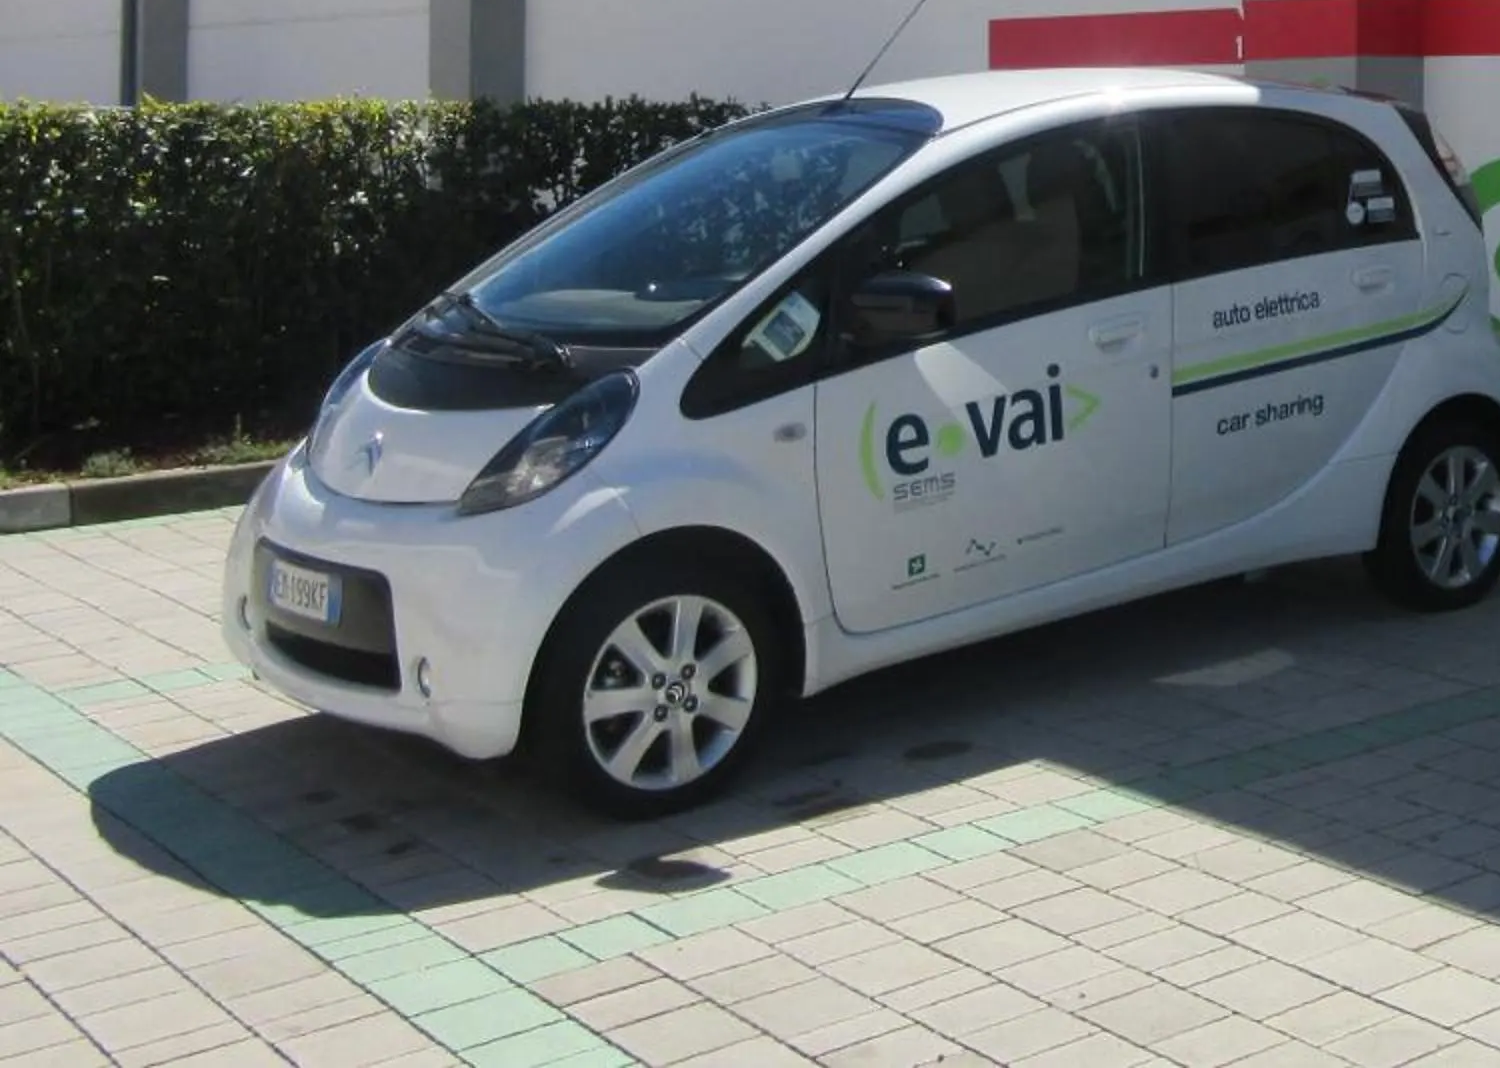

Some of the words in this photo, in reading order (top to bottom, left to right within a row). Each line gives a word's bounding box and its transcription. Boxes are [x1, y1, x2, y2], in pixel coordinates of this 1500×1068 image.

[1236, 35, 1243, 60] 1
[1213, 302, 1251, 329] auto
[1254, 291, 1320, 321] elettrica
[1216, 412, 1250, 436] car
[1255, 393, 1324, 428] sharing
